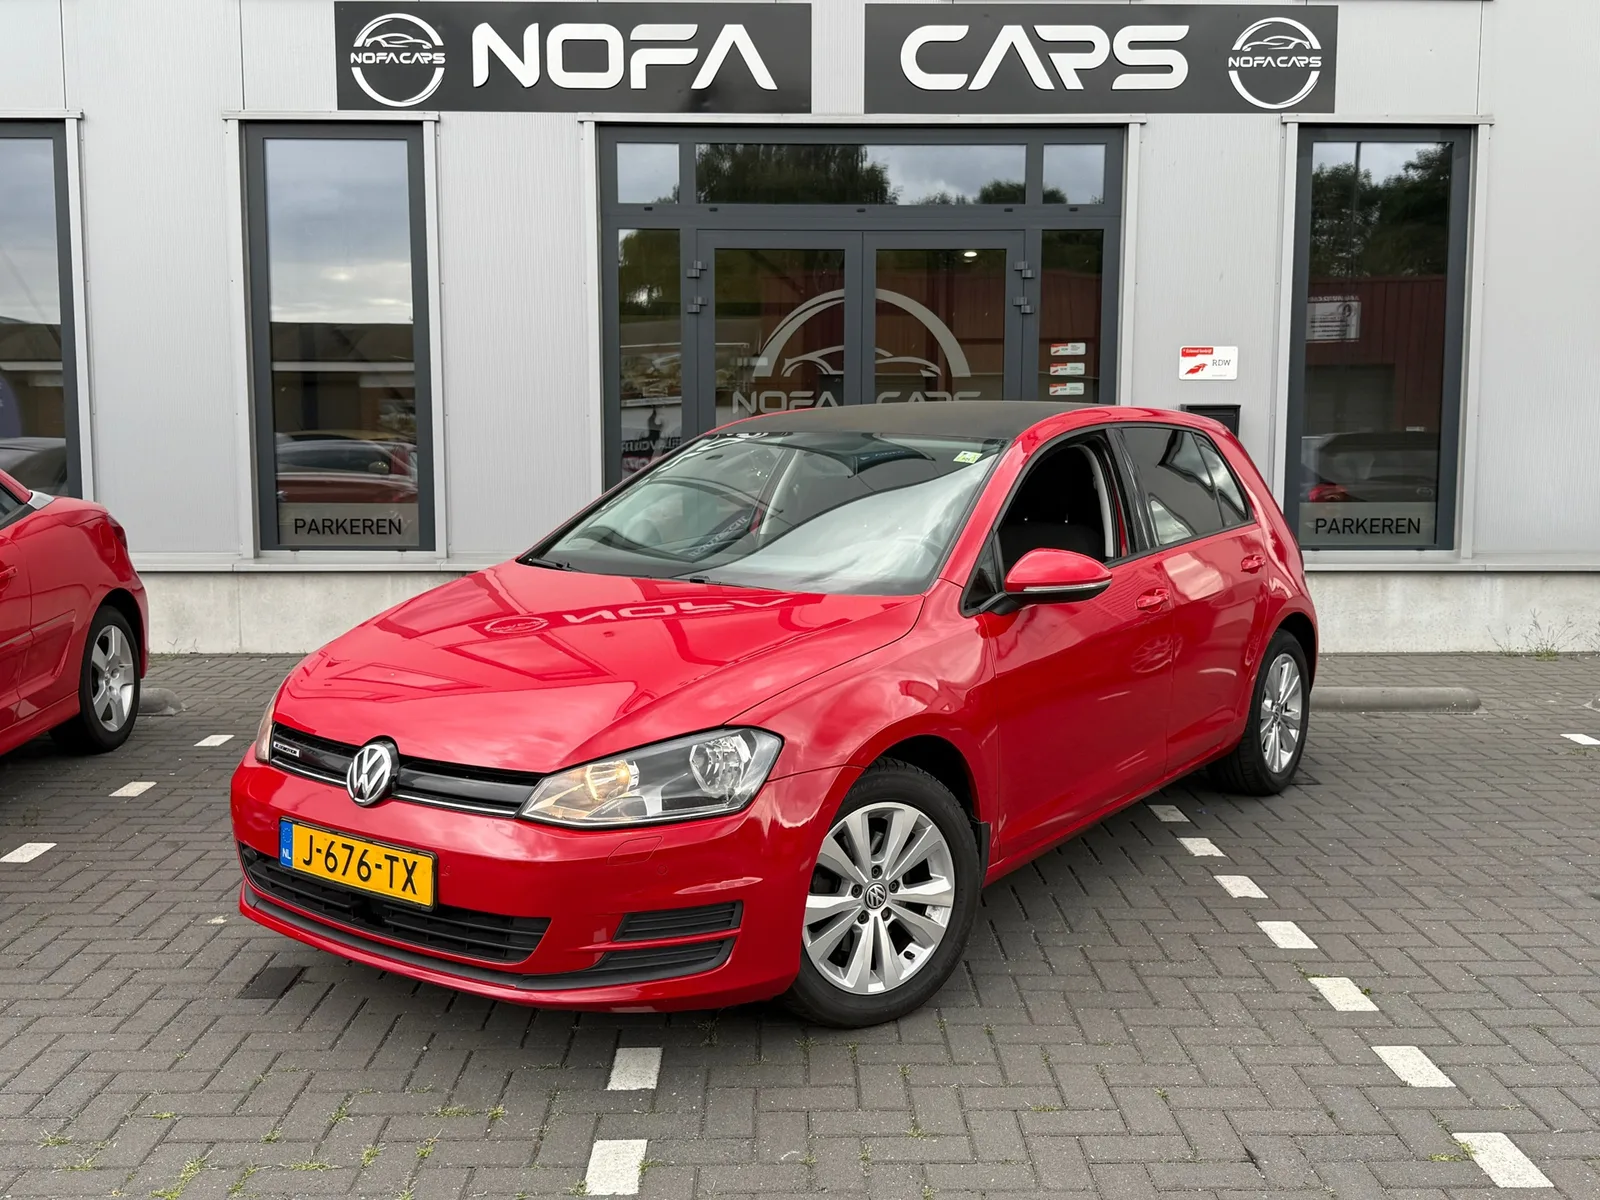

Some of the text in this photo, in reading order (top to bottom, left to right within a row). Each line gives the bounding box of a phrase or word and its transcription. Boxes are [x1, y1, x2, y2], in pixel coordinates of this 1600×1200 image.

[472, 22, 1190, 91] NOFA CARS
[1212, 358, 1231, 367] RDW
[732, 390, 839, 414] NOFA
[295, 518, 403, 536] PARKEREN
[1314, 517, 1421, 535] PARKEREN
[282, 848, 292, 860] NL
[302, 834, 418, 895] J-676-TX
